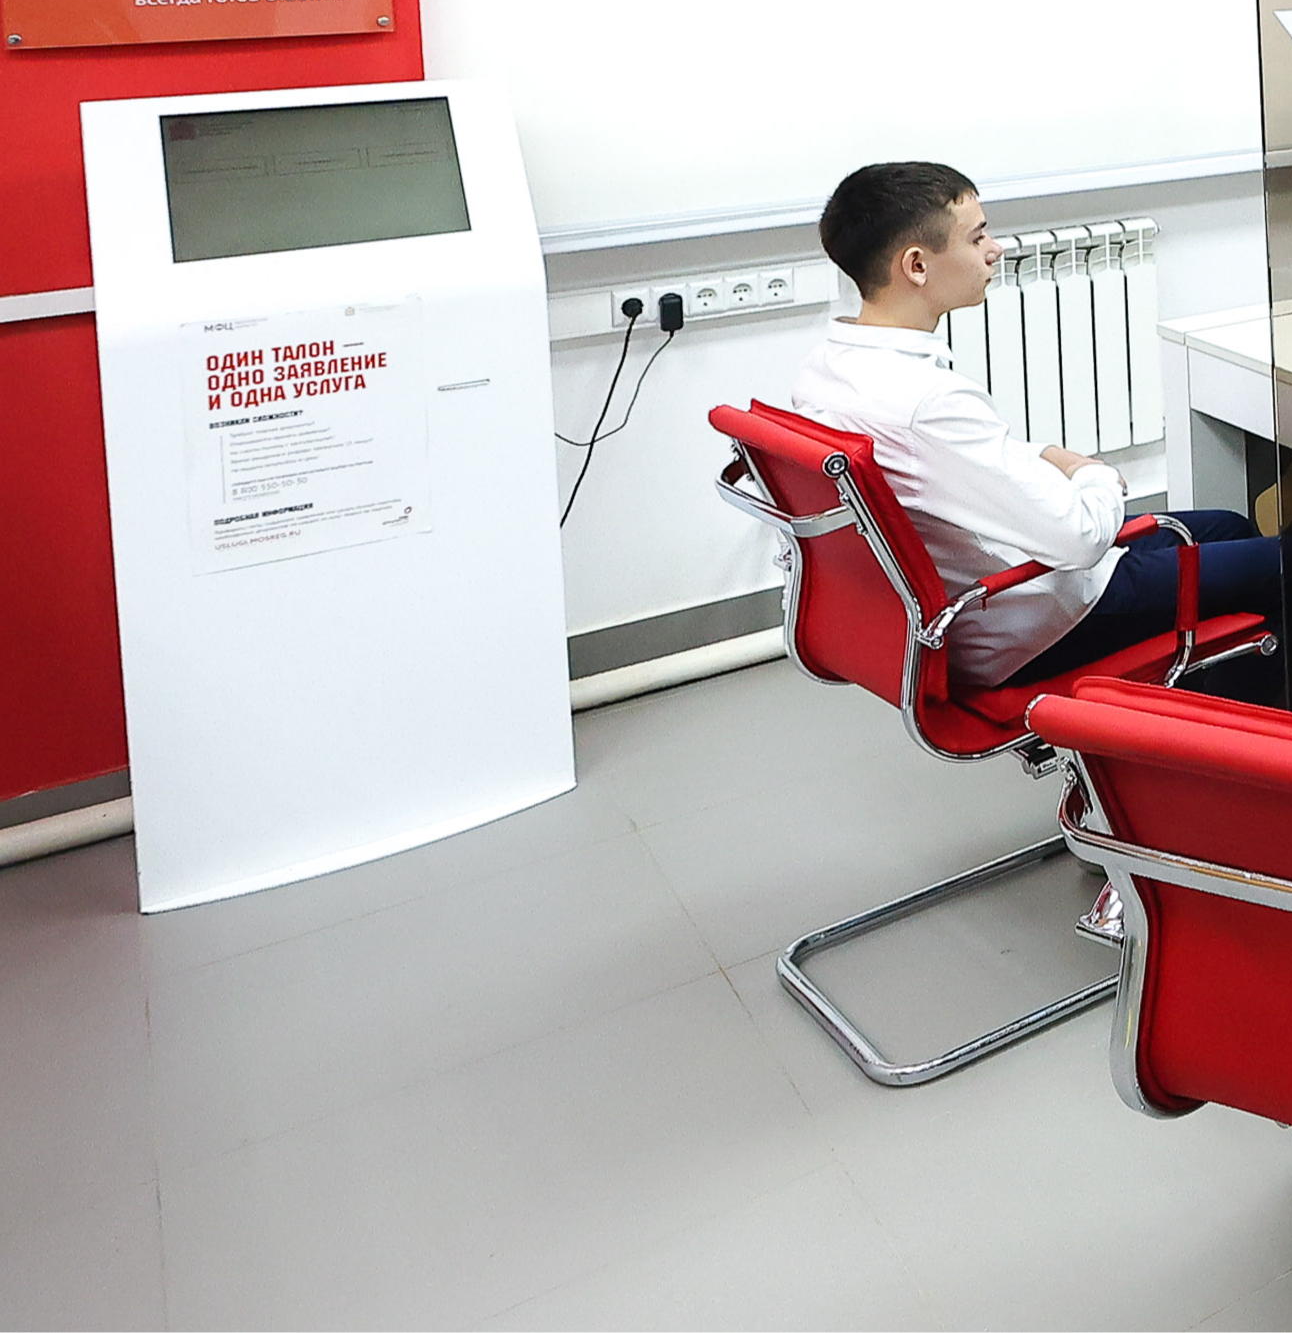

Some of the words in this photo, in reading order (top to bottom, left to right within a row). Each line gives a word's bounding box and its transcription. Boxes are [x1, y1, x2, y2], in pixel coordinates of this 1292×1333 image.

[204, 322, 234, 333] МФЦ
[206, 349, 264, 373] ОДИН
[271, 340, 334, 364] ТАЛОН
[208, 368, 264, 392] ОДНО
[274, 352, 388, 382] ЗАЯВЛЕНИЕ
[208, 394, 221, 411] И
[230, 387, 287, 408] ОДНА
[292, 374, 367, 399] УСЛУГА
